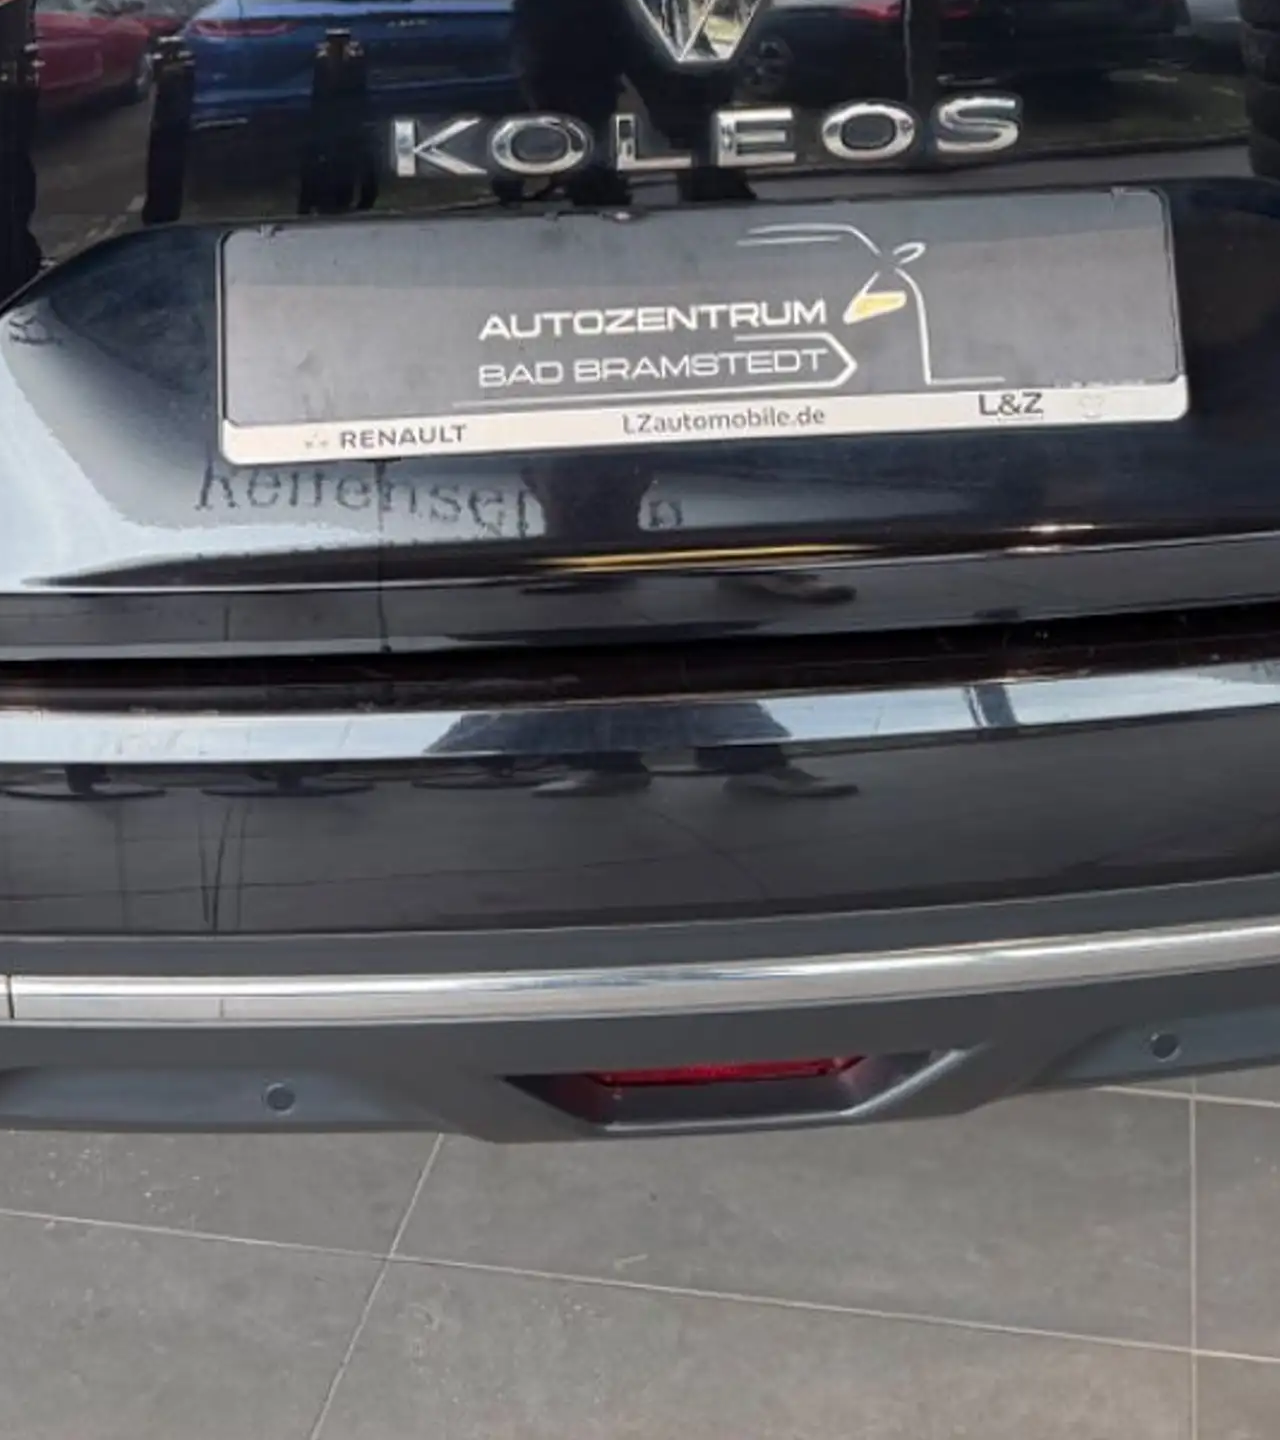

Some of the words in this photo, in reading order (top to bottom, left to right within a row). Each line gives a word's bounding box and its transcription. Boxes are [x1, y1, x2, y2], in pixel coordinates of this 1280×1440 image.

[392, 96, 1020, 178] KOLEOS
[478, 298, 827, 341] AUTOZENTRUM
[478, 360, 564, 389] BAD
[573, 348, 829, 384] BRAMSTEDT
[621, 406, 826, 435] LZautomobile.de
[978, 391, 1045, 417] L&Z
[339, 424, 467, 450] RENAULT
